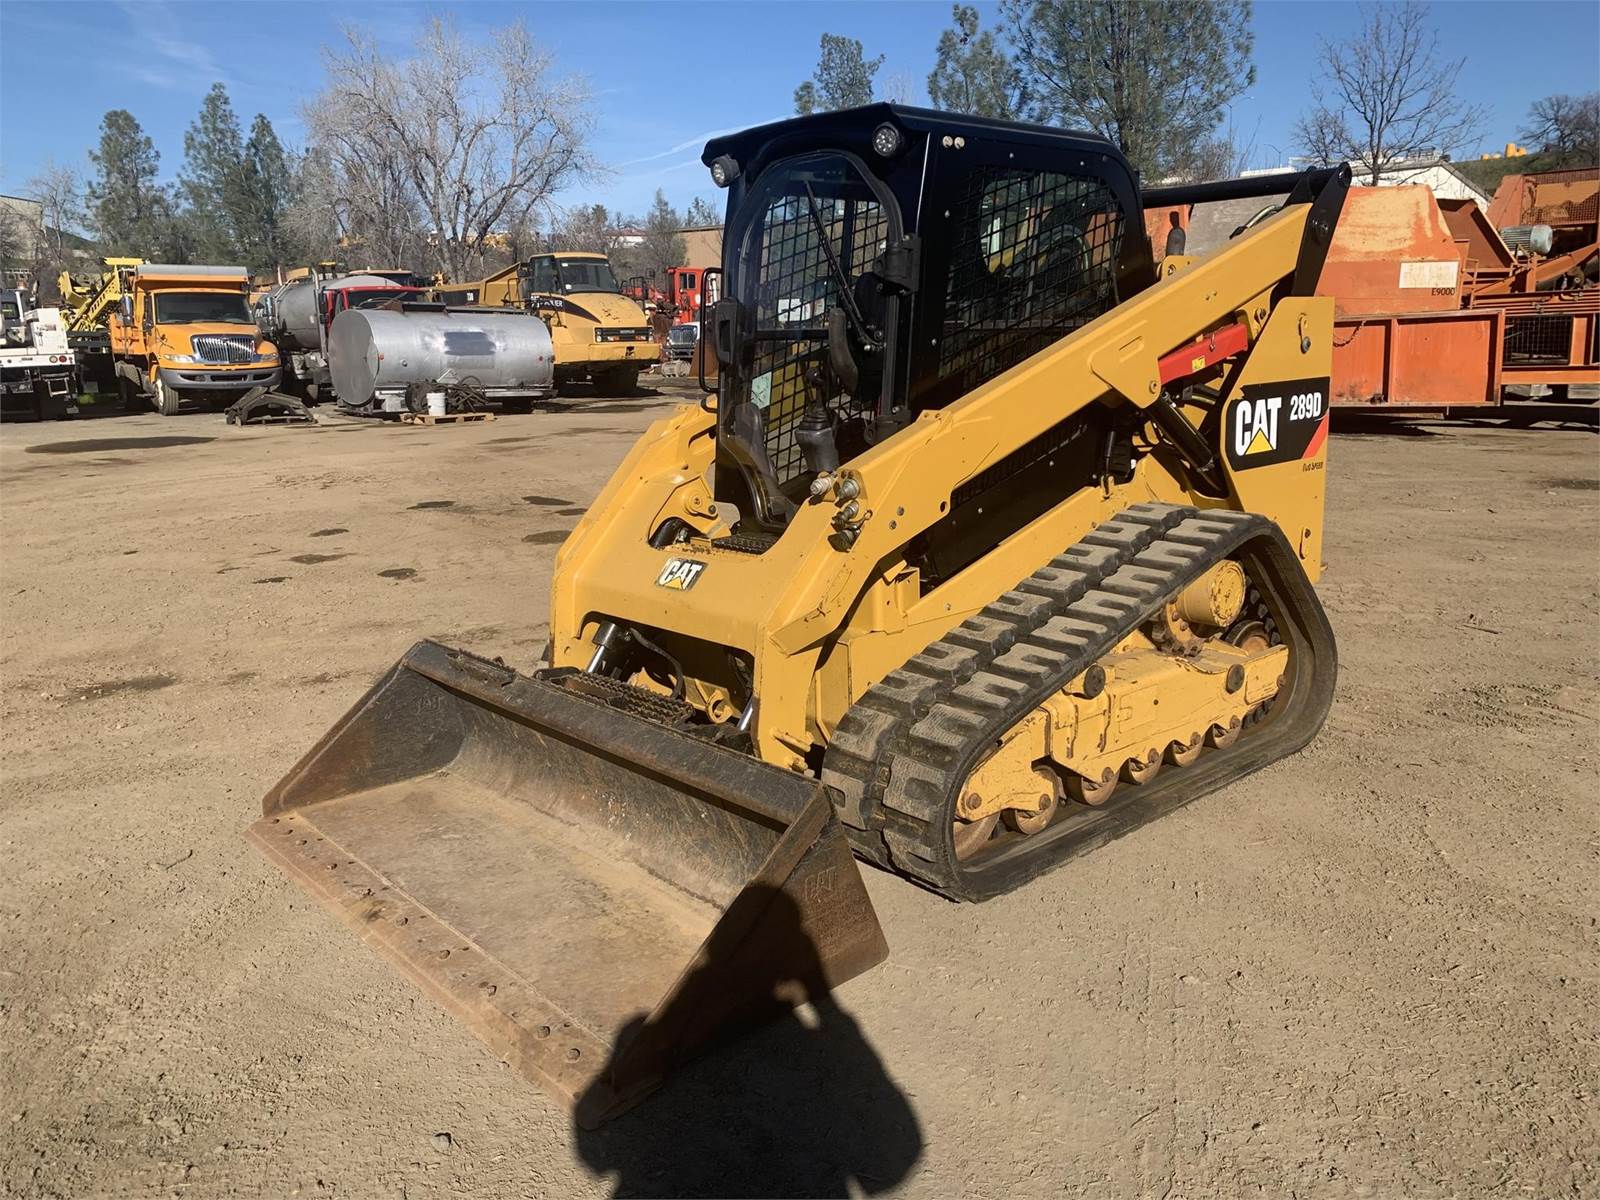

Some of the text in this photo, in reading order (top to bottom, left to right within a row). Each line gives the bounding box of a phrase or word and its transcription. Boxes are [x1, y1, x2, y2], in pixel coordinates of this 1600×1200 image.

[1431, 287, 1456, 296] E9000
[1235, 391, 1322, 456] CAT 289D
[658, 560, 703, 590] CAT
